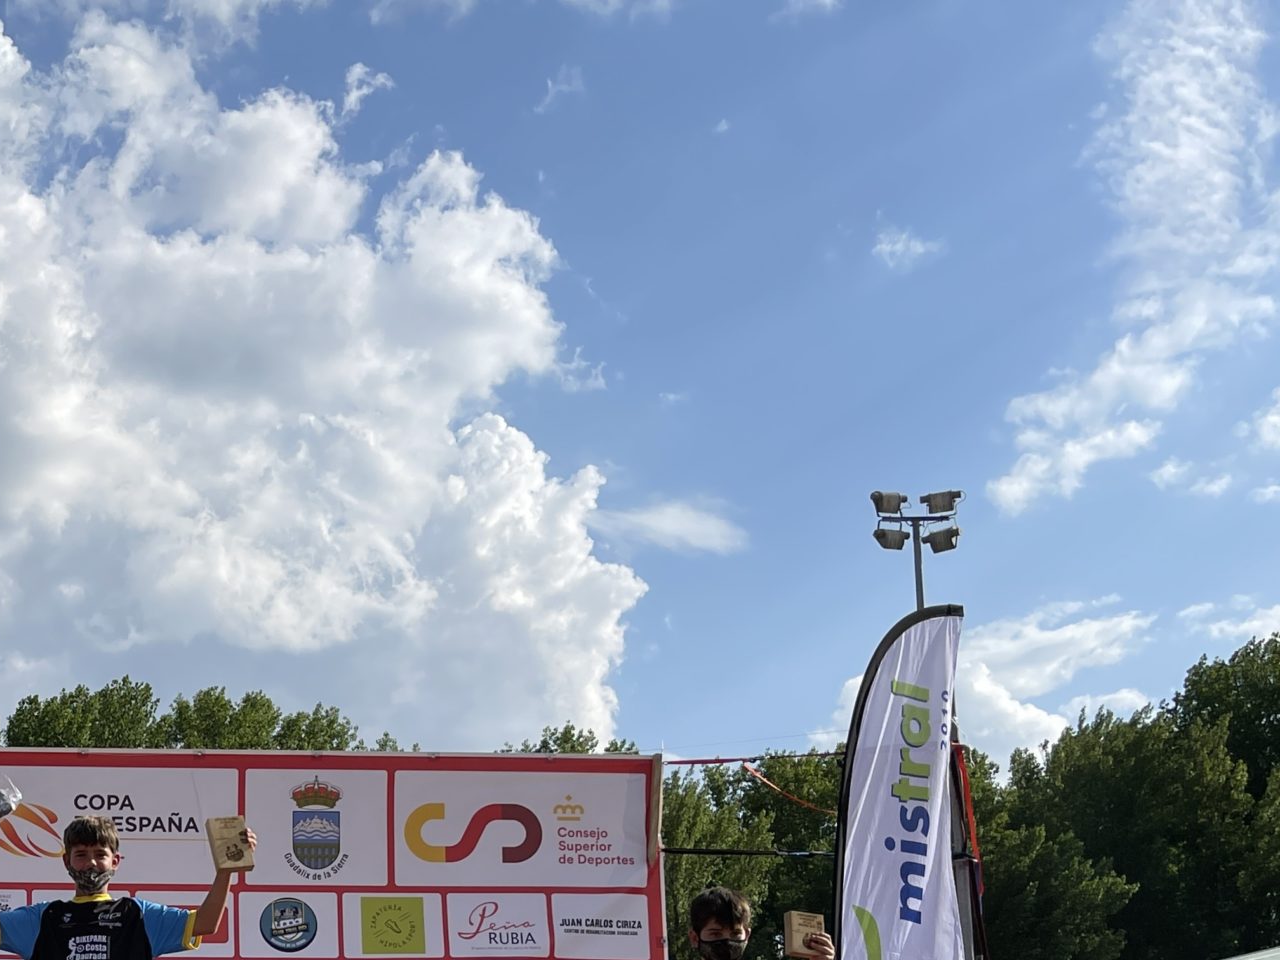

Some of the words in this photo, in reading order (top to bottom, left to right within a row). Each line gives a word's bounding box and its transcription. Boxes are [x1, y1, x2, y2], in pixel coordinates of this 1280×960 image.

[73, 794, 134, 811] COPA
[885, 681, 931, 924] mistral
[115, 812, 199, 833] ESPAÑA
[557, 827, 608, 840] Consejo
[558, 840, 612, 853] Superior
[284, 852, 310, 880] Guadalix
[323, 871, 331, 879] la
[331, 853, 349, 874] Sierra
[558, 854, 574, 864] de
[578, 854, 635, 867] Deportes
[559, 918, 582, 927] JUAN
[585, 919, 613, 928] CARLOS
[616, 920, 642, 929] CIRIZA
[75, 935, 107, 943] BIKEPARK
[489, 932, 536, 945] RUBIA
[85, 943, 107, 951] Costa
[75, 952, 107, 960] Daurada
